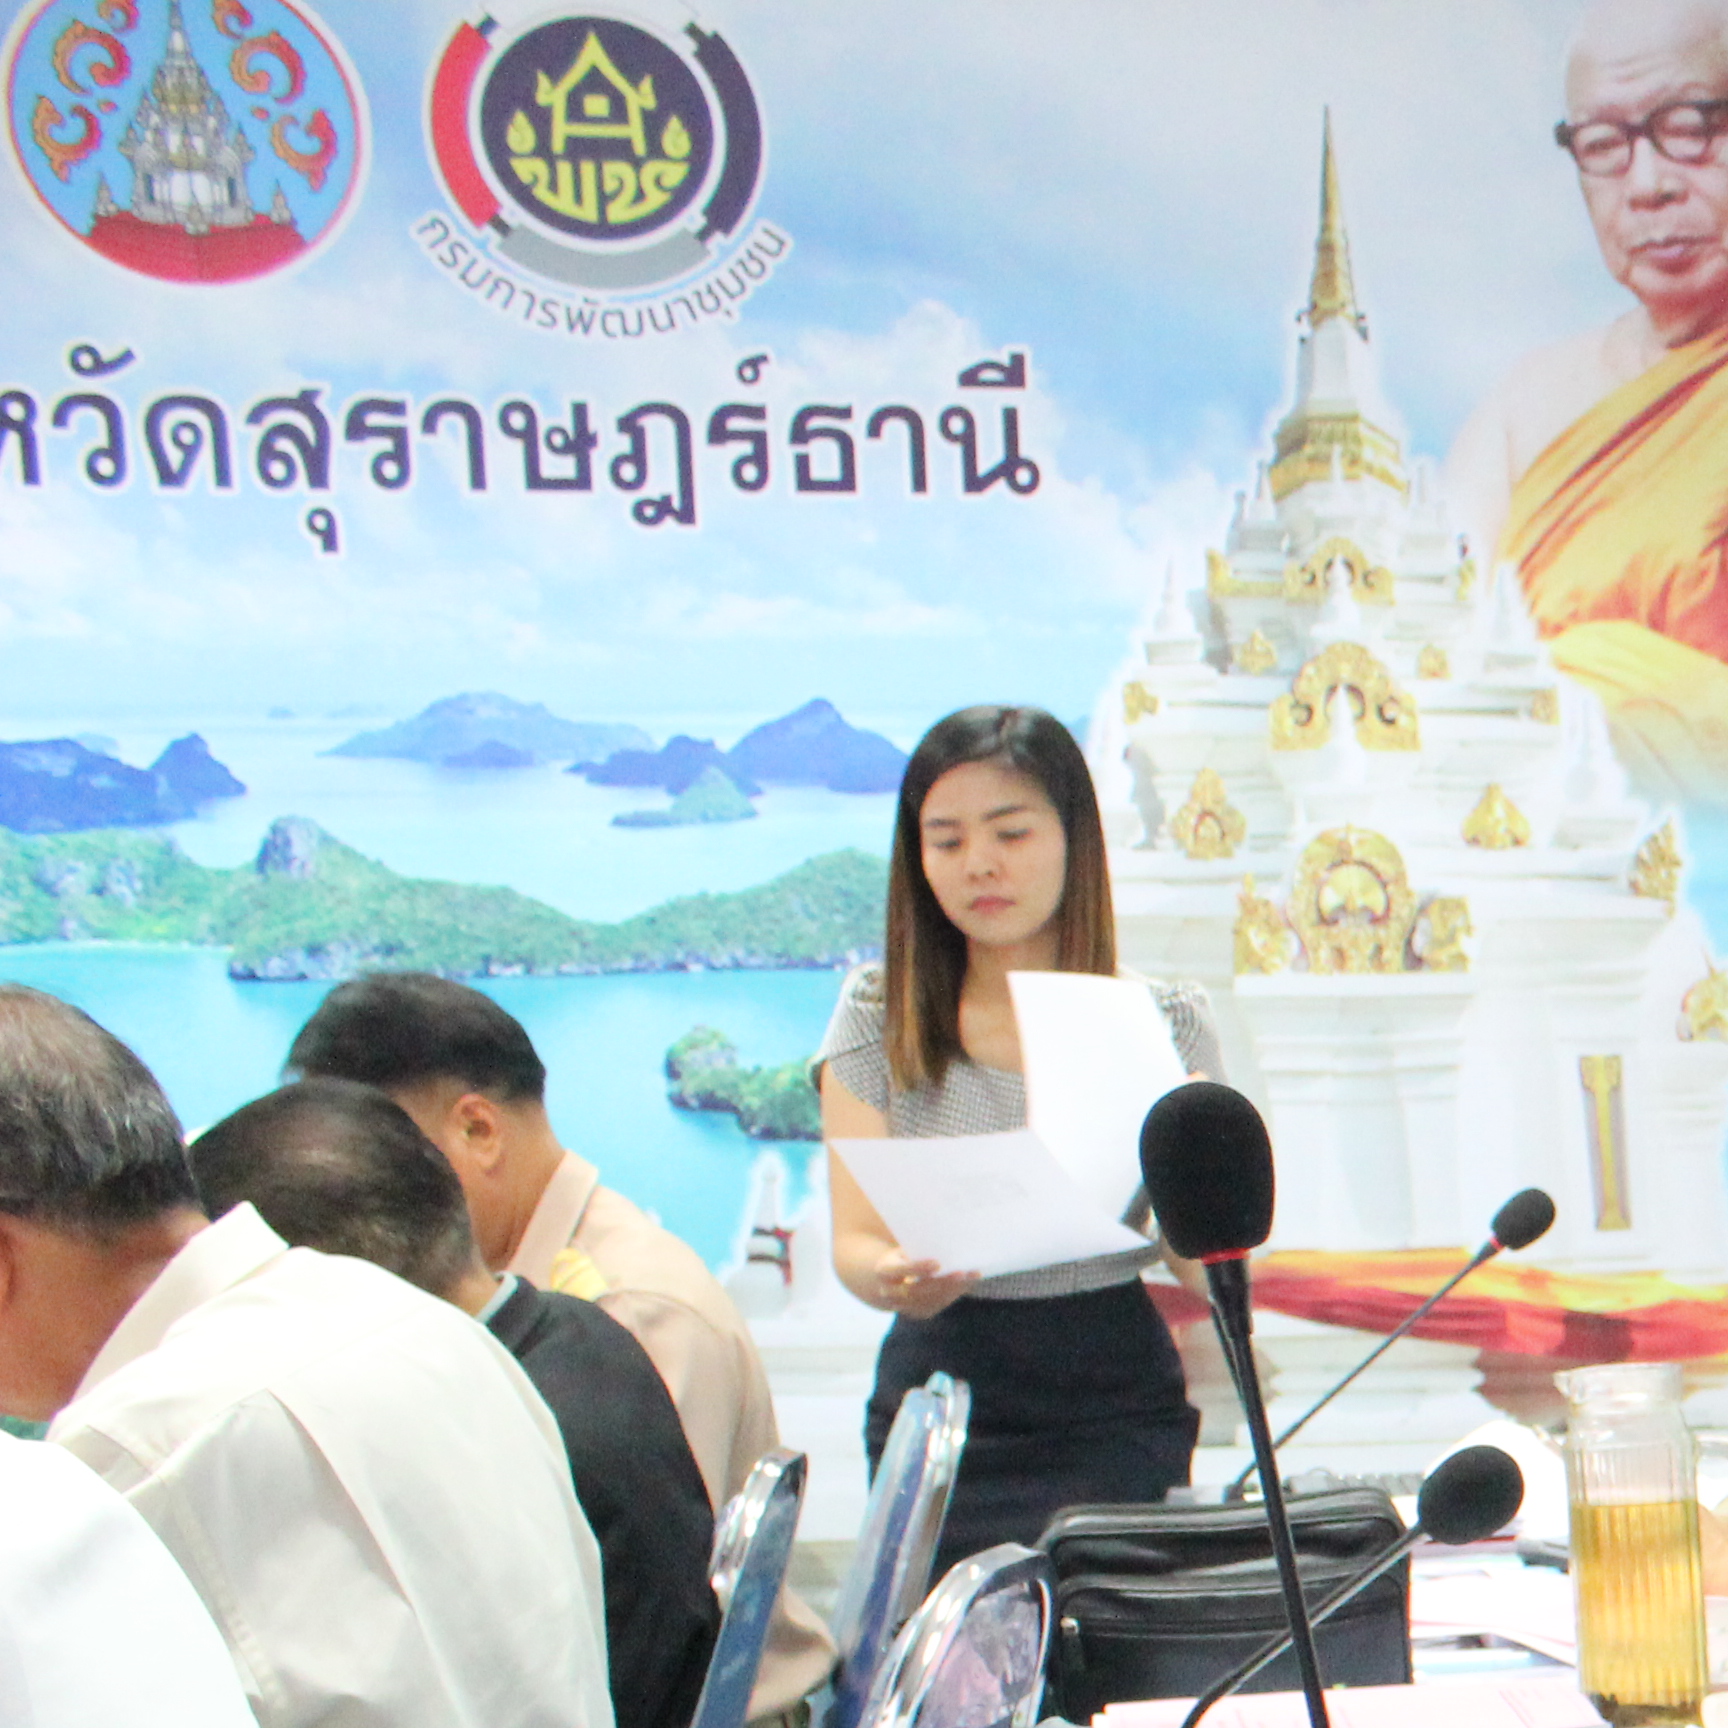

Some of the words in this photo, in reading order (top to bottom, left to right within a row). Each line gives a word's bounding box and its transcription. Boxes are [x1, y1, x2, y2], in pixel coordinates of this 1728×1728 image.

[417, 215, 787, 338] กรมการพัฒนาชุมชน
